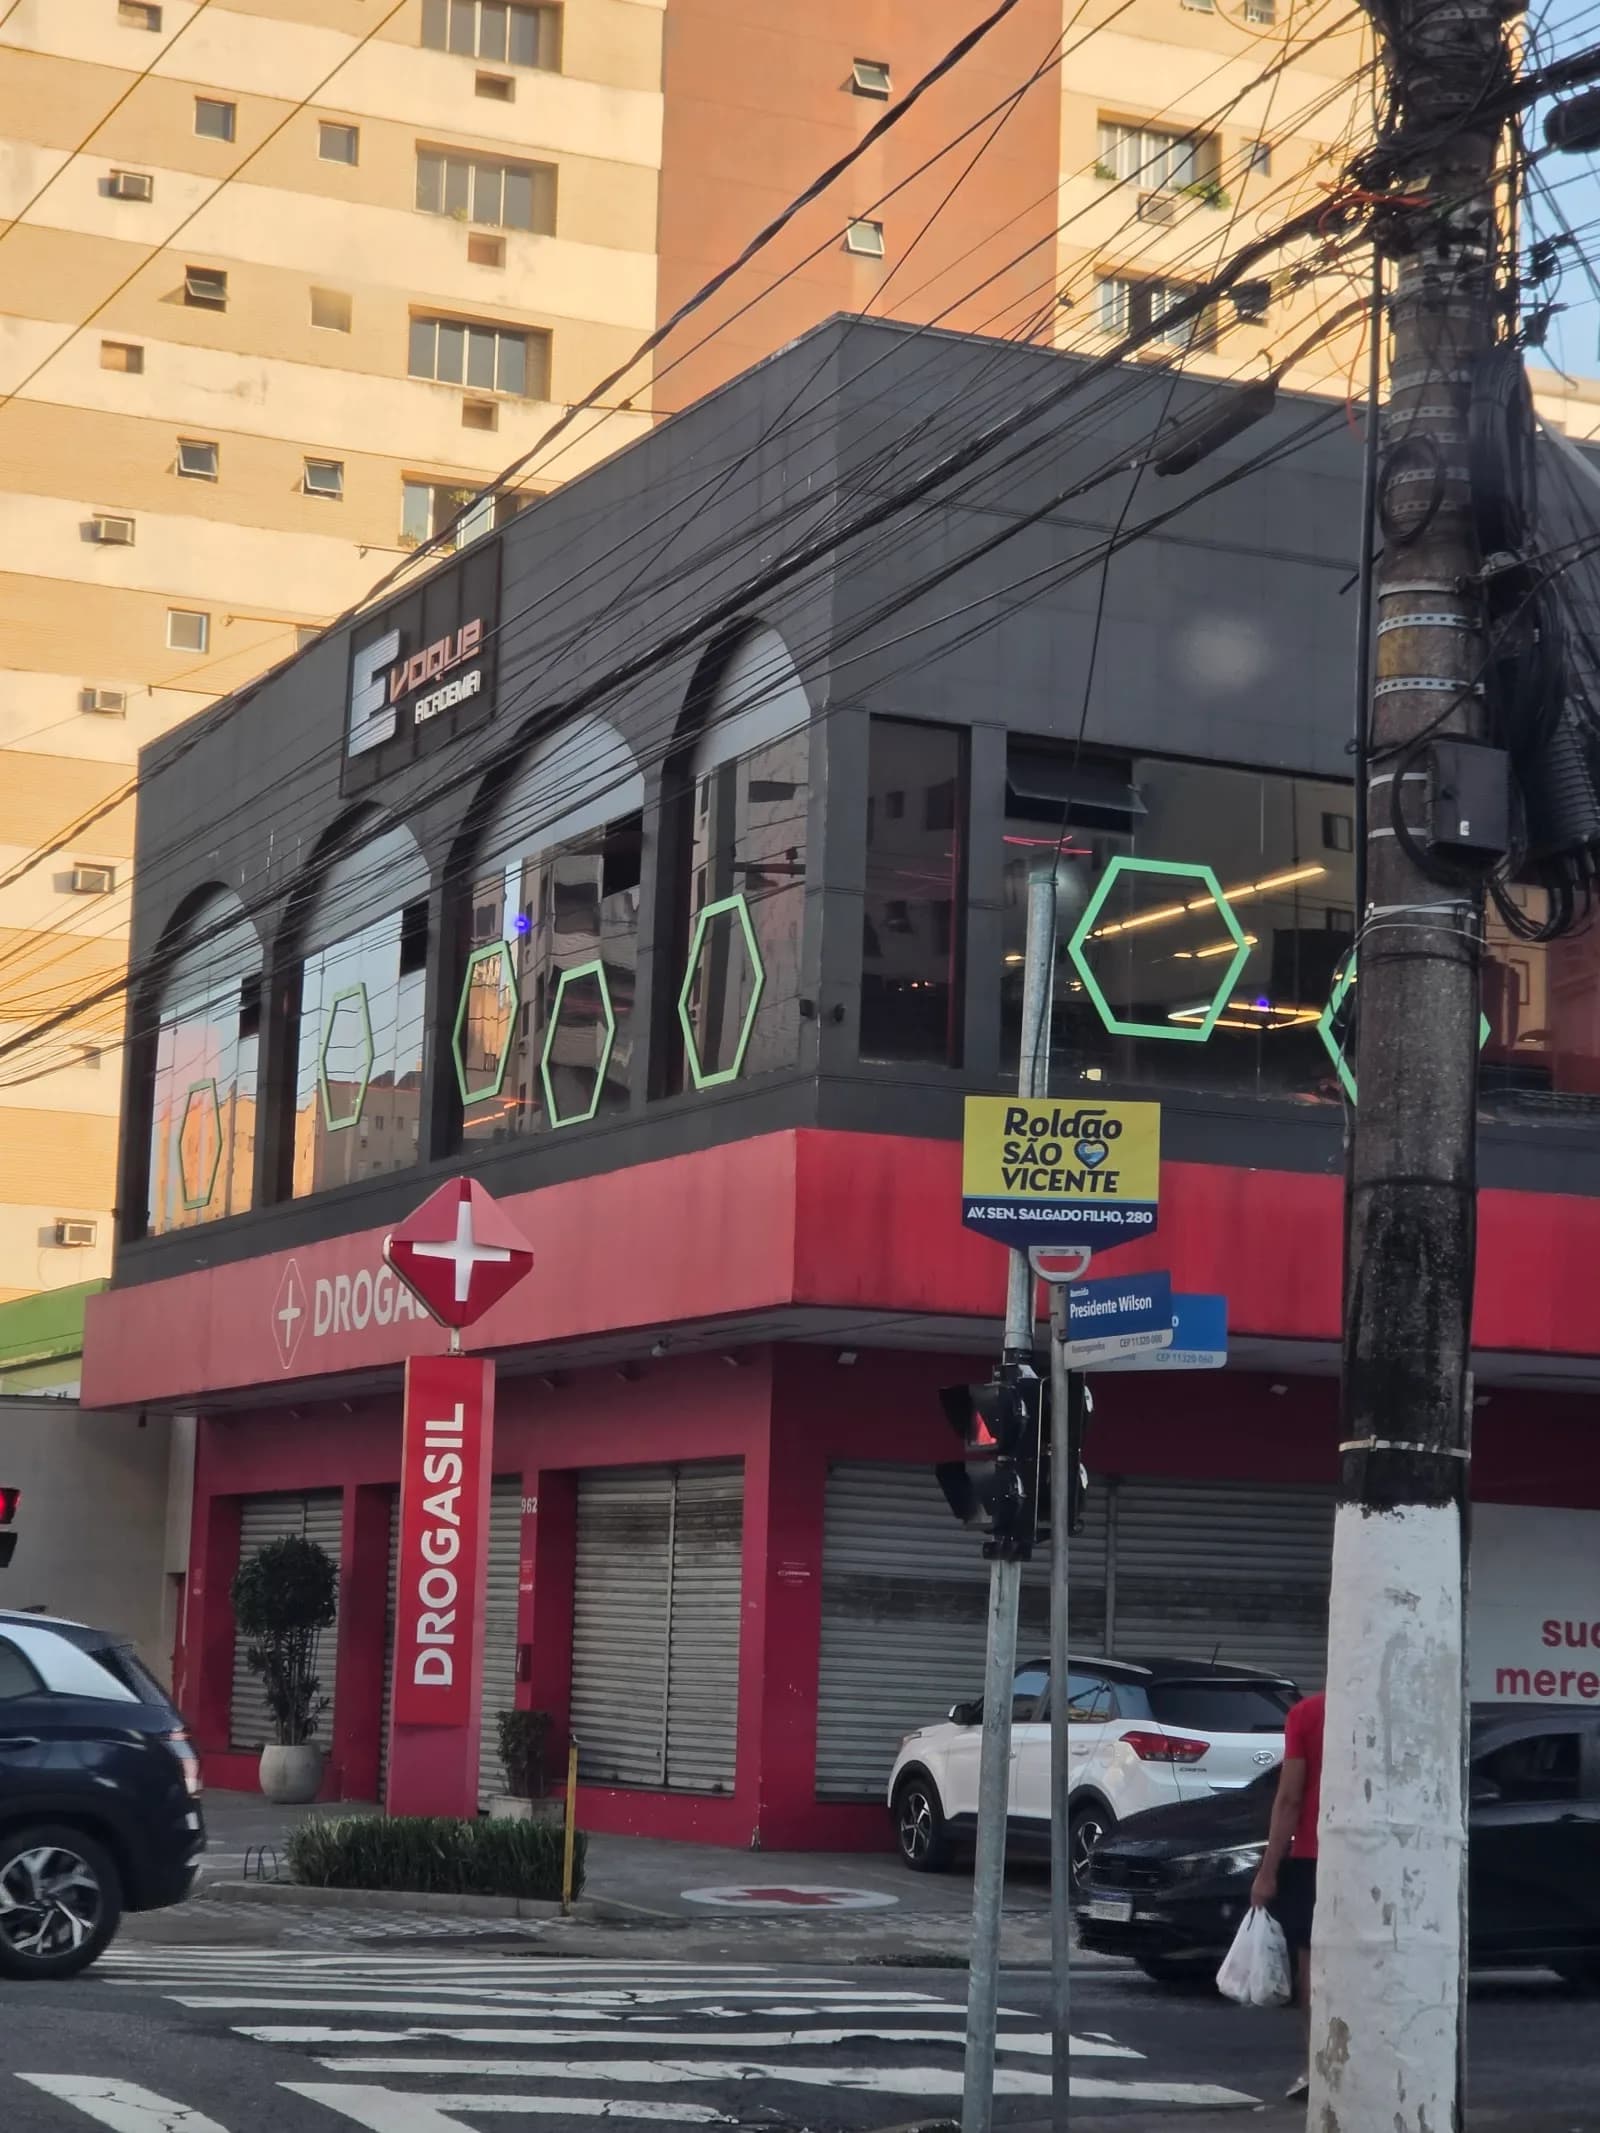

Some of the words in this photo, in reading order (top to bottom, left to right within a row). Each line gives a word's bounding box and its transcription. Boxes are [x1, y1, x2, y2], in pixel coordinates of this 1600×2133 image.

[415, 670, 481, 724] ACADEMIA
[1002, 1137, 1062, 1166] SÃO
[1001, 1167, 1120, 1193] VICENTE
[967, 1206, 985, 1219] AV.
[987, 1207, 1017, 1220] SEN.
[1018, 1208, 1082, 1221] SALGADO
[1083, 1210, 1124, 1225] FILHO,
[1126, 1211, 1153, 1224] 280
[314, 1264, 429, 1337] DROGA
[1070, 1301, 1117, 1319] Presidente
[1118, 1294, 1152, 1313] Wilson
[521, 1497, 538, 1514] 962
[414, 1403, 464, 1686] DROGASIL
